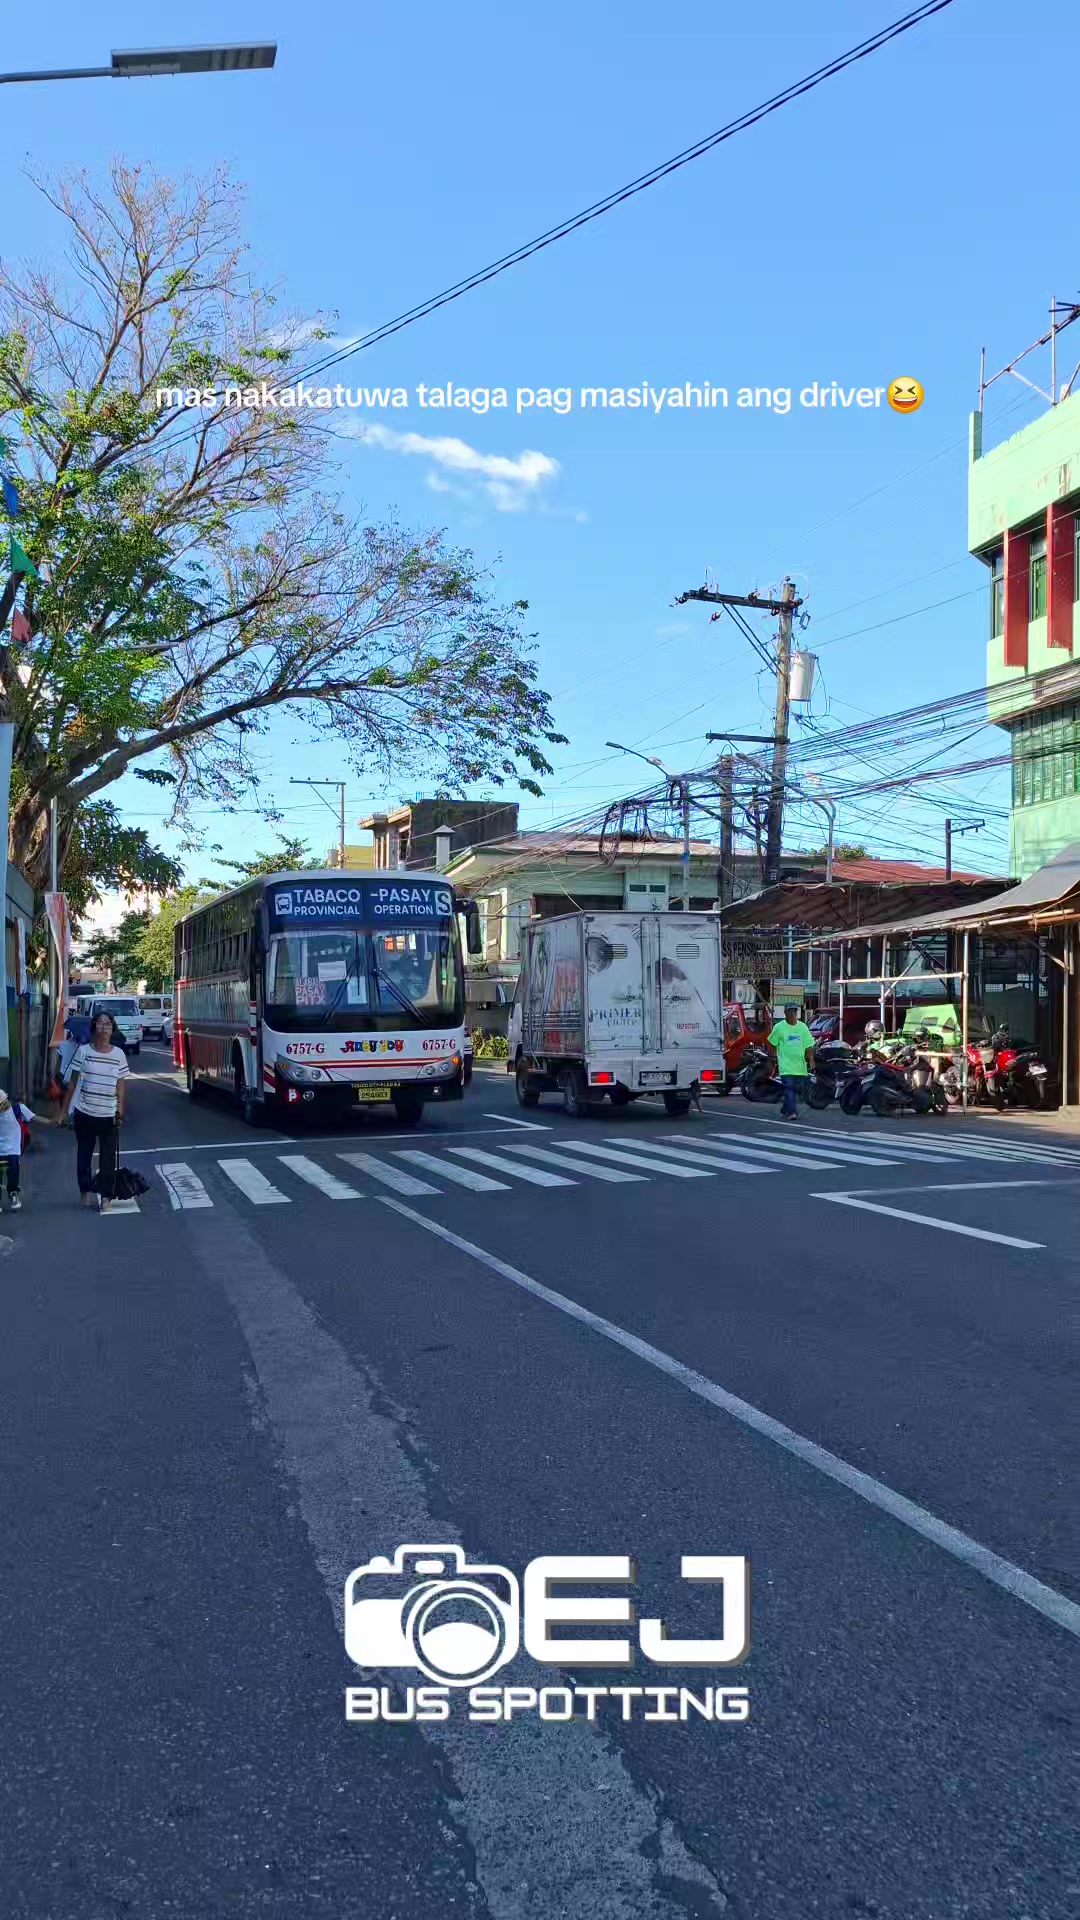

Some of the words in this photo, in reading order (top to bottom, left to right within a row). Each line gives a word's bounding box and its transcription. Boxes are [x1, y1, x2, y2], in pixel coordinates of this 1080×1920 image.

[293, 888, 361, 903] TABACO
[293, 905, 360, 915] PROVINCIAL
[374, 904, 434, 915] OPERATION
[295, 986, 326, 997] PASAY
[295, 996, 326, 1006] PITX
[286, 1042, 325, 1055] 6757-G
[422, 1039, 456, 1051] 6757-G
